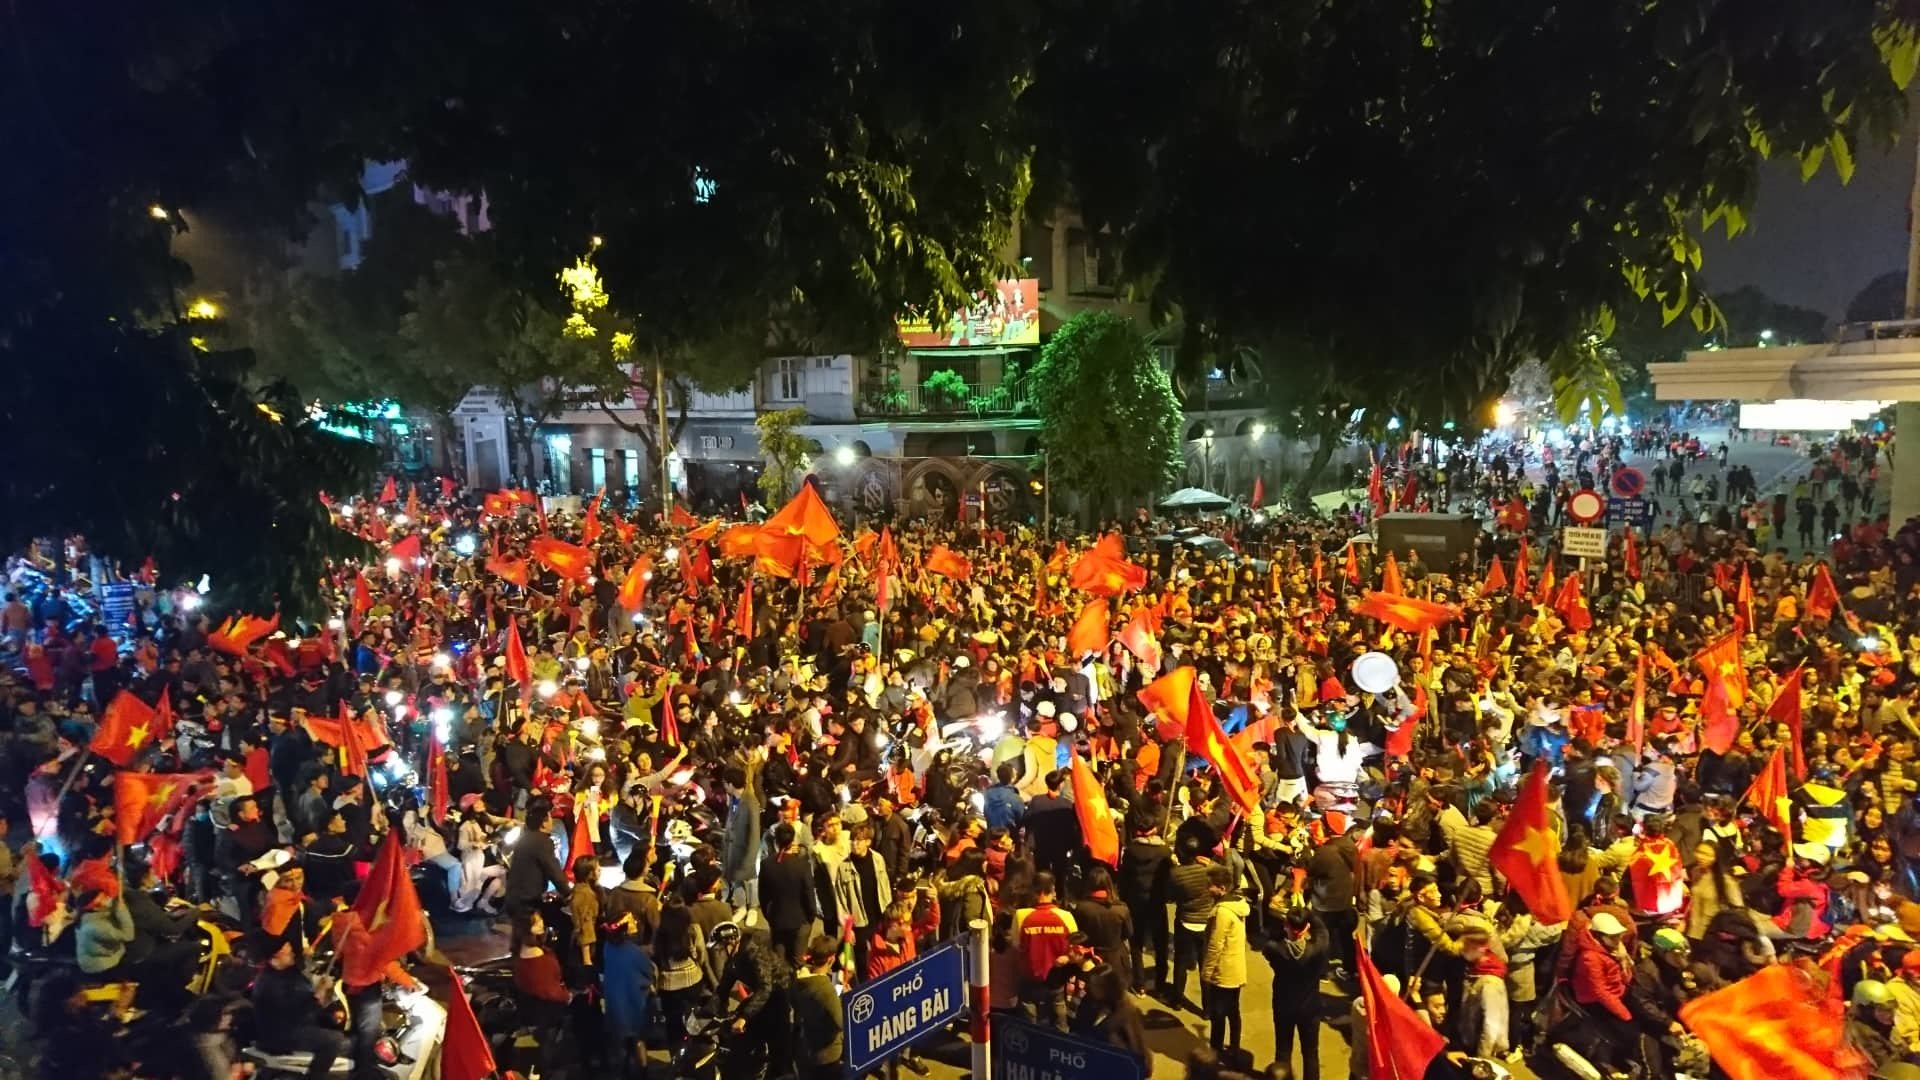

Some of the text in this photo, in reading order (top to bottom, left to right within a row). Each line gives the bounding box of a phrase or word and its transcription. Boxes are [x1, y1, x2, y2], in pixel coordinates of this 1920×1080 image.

[1043, 925, 1064, 934] NAM
[893, 971, 924, 1002] PHỐ
[868, 987, 950, 1052] HÀNG BÀI
[1049, 1047, 1088, 1069] PHỐ
